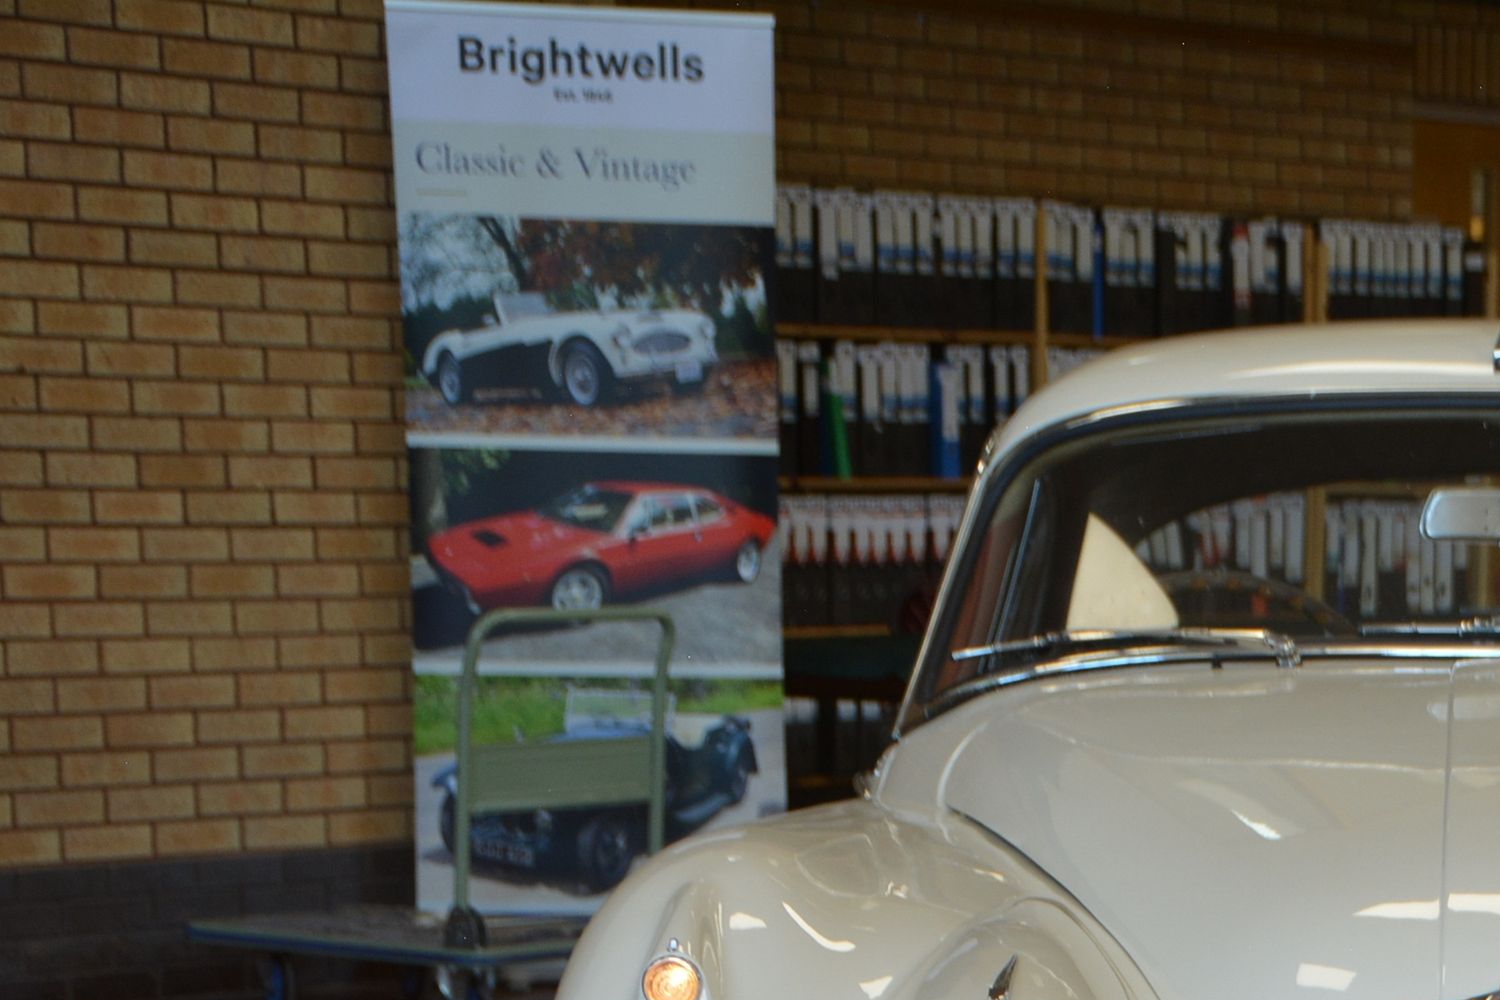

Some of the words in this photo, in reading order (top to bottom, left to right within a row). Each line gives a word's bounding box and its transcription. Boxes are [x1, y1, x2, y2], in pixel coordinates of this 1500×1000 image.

[458, 35, 704, 84] Brightwells
[414, 141, 526, 179] Classic
[536, 147, 561, 180] &
[573, 147, 697, 191] Vintage
